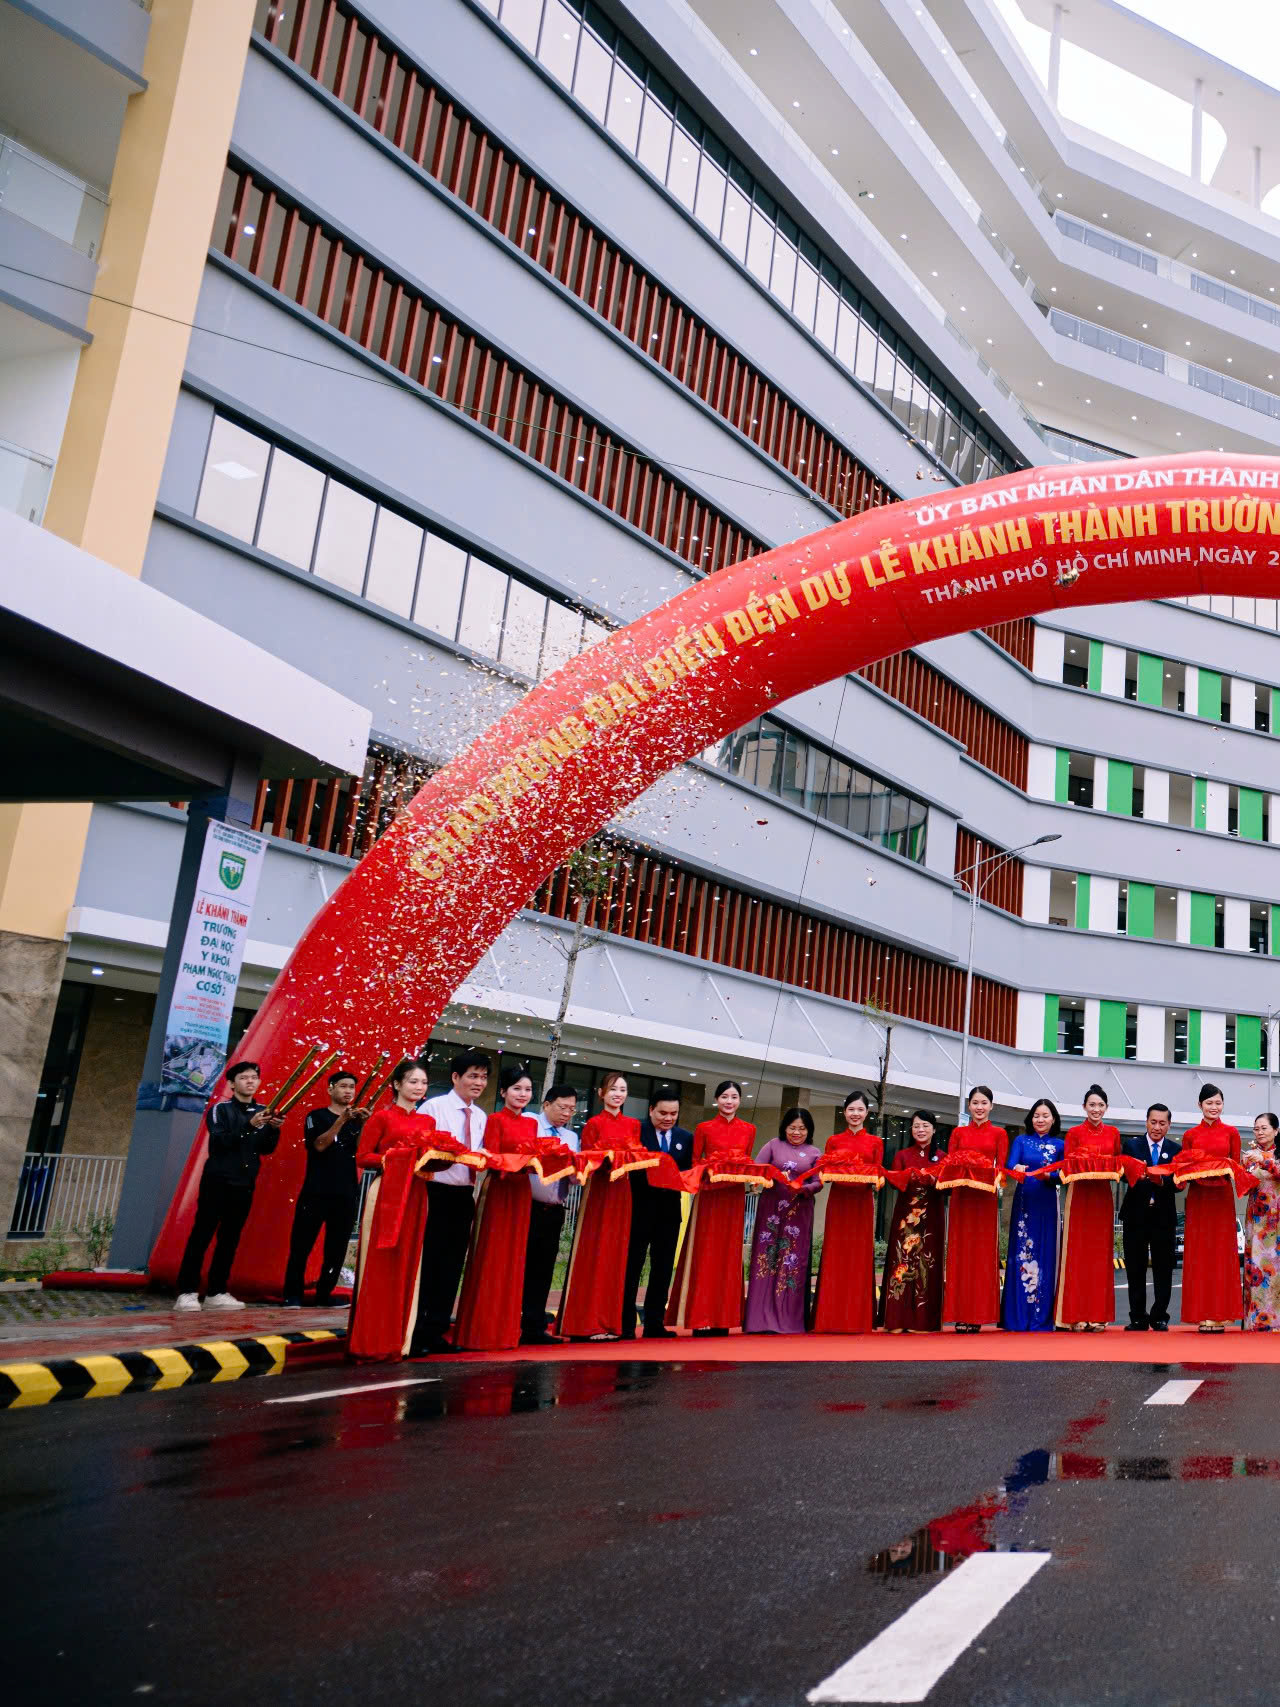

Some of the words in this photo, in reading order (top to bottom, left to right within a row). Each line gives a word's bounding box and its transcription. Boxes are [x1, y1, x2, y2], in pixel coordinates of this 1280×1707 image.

[961, 488, 1018, 516] BAN
[1027, 476, 1108, 501] NHÂN
[1113, 470, 1175, 491] DÂN
[1183, 467, 1279, 488] THÀNH
[921, 573, 997, 604] THÀNH
[1002, 557, 1048, 587] PHỐ
[1056, 550, 1088, 577] HỒ
[1093, 548, 1129, 570] CHÍ
[583, 671, 650, 727] ĐẠI
[643, 623, 726, 689] BIỂU
[723, 587, 801, 645] ĐẾN
[800, 561, 852, 611] DỰ
[860, 538, 906, 588] LỄ
[909, 517, 1033, 575] KHÁNH
[1038, 502, 1157, 545] THÀNH
[201, 951, 210, 960] Y
